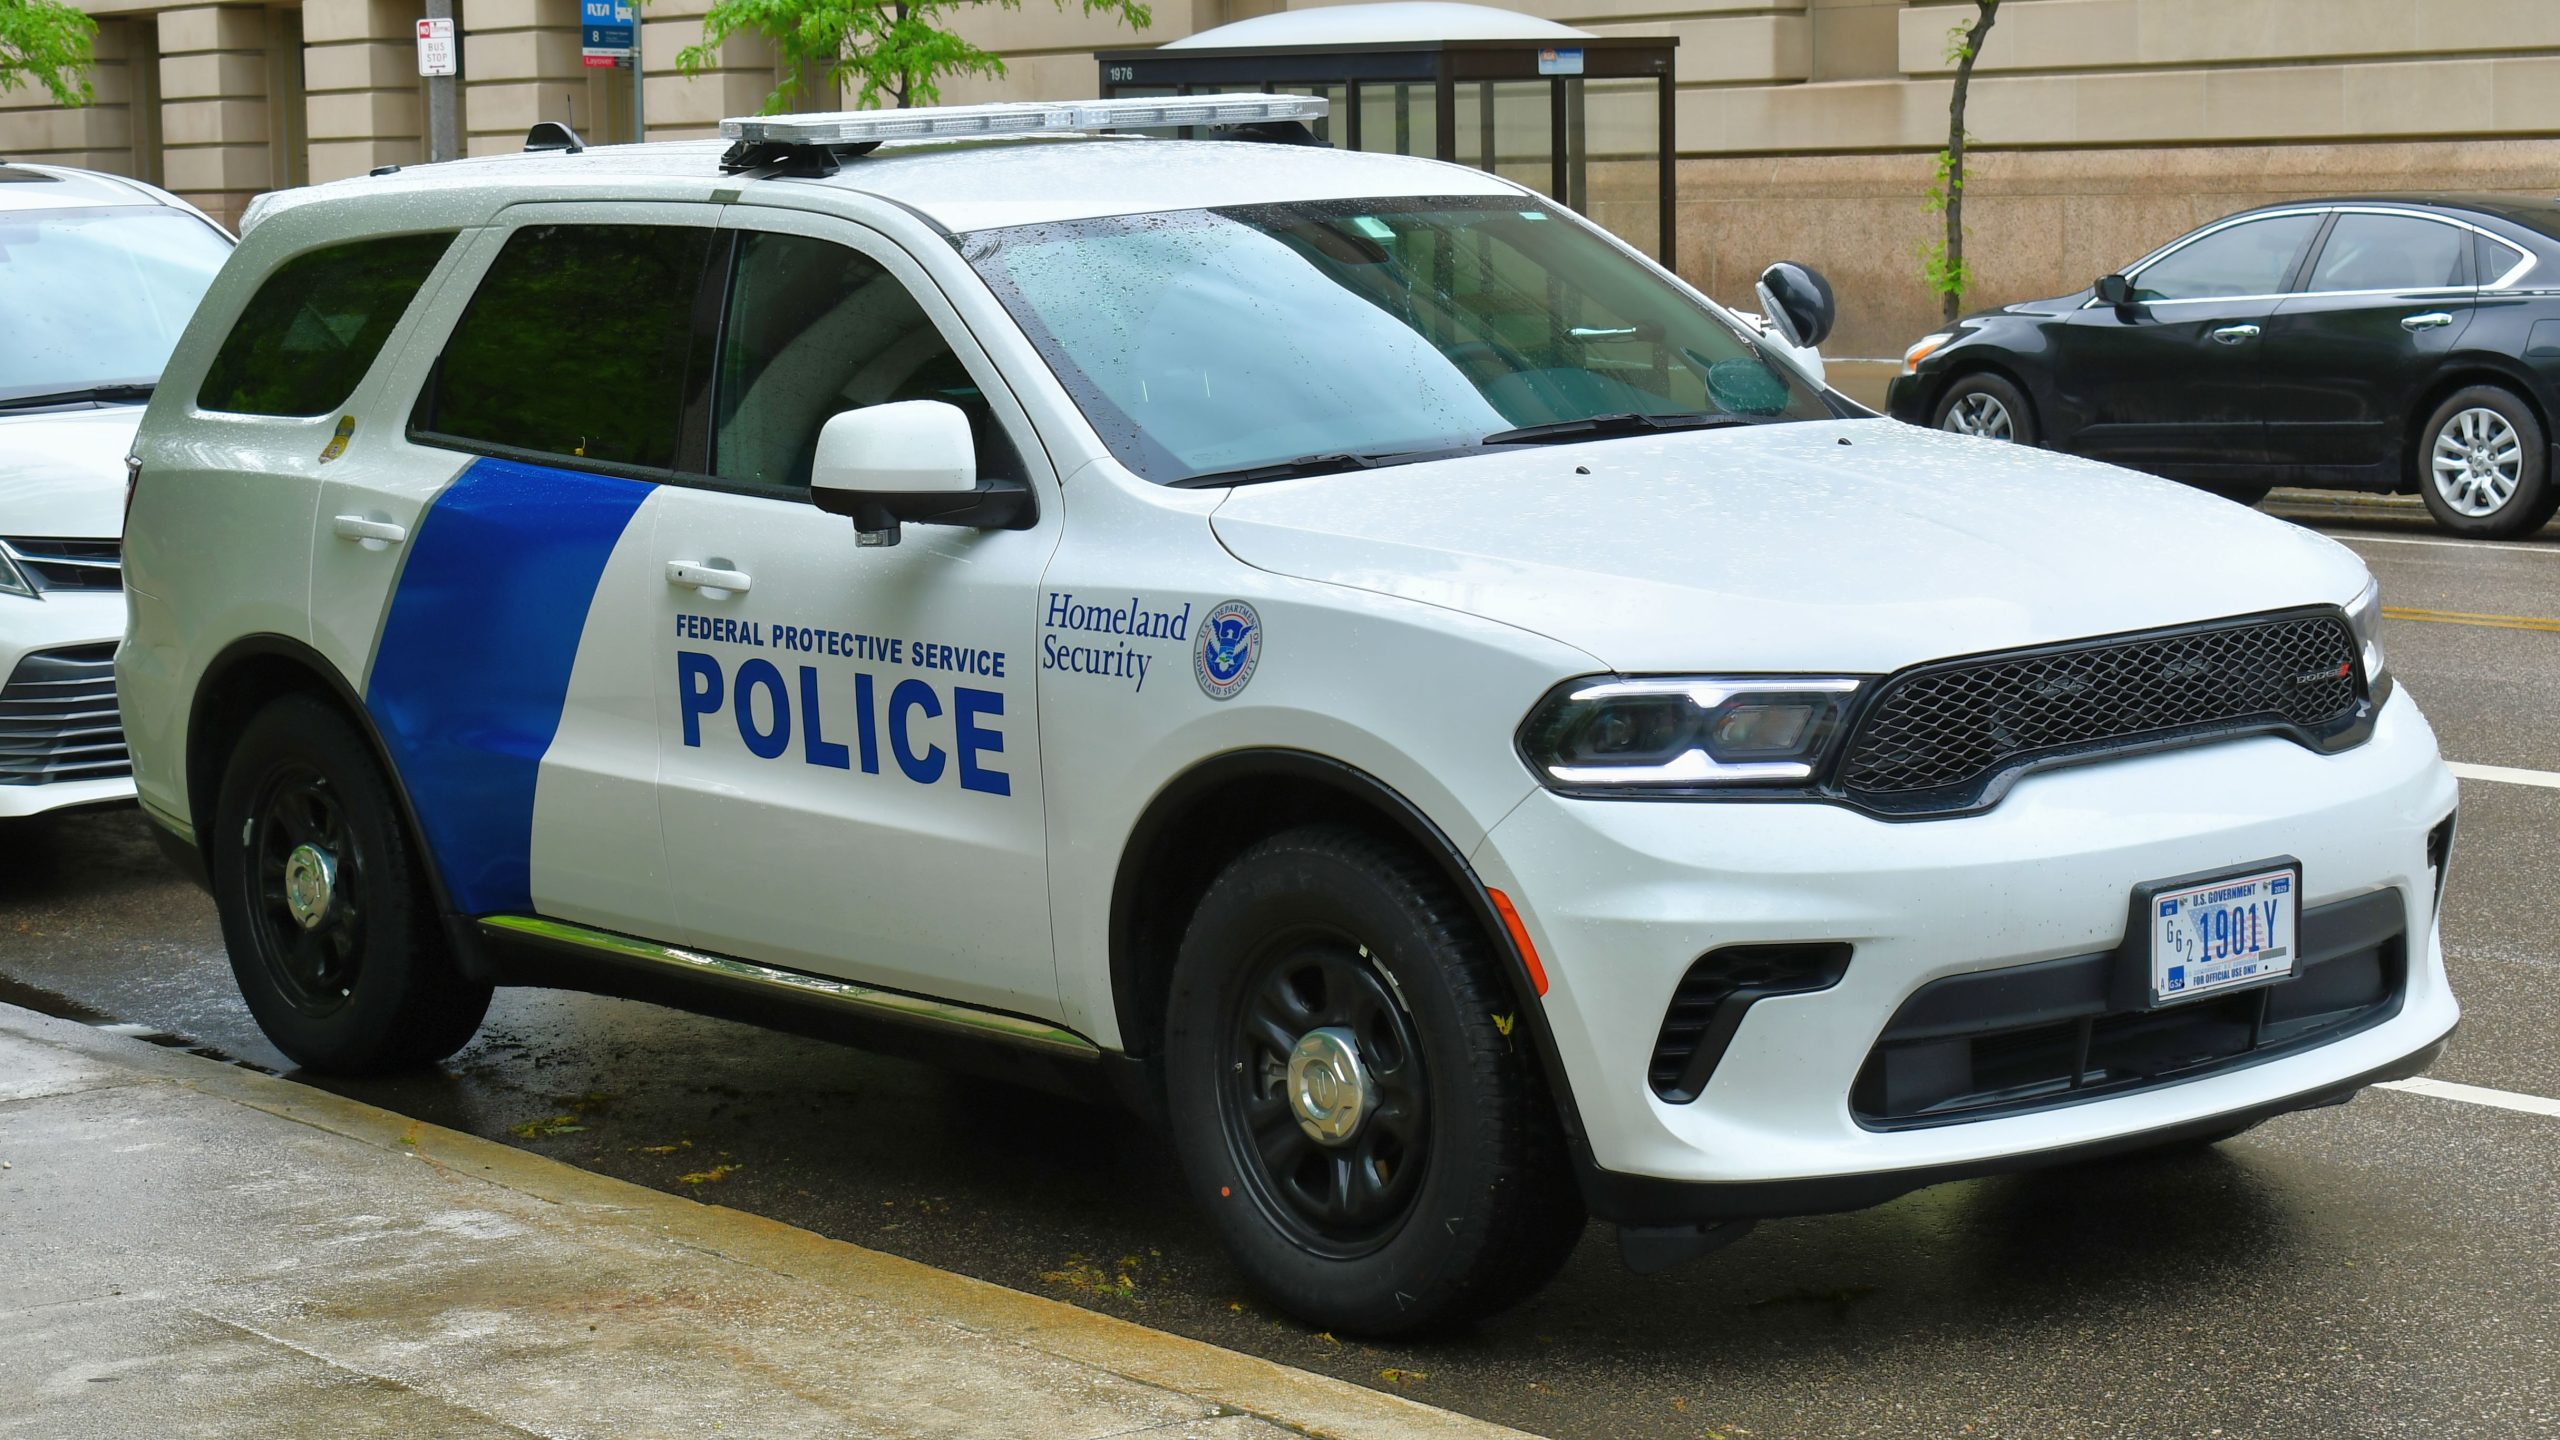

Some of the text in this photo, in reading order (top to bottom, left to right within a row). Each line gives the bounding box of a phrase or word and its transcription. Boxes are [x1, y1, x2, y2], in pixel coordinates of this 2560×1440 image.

[587, 3, 610, 16] RTA
[428, 43, 445, 51] BUS
[592, 30, 599, 42] 8
[427, 53, 447, 62] STOP
[1110, 67, 1133, 80] 1976
[1045, 592, 1191, 641] Homeland
[1215, 605, 1258, 632] DEPARTMENT
[1253, 632, 1259, 646] OF
[676, 614, 1005, 678] FEDERAL PROTECTIVE SERVICE
[1043, 634, 1152, 693] Security
[1196, 651, 1255, 695] HOMELAND SECURITY
[2297, 668, 2340, 683] DODGE
[677, 650, 1011, 797] POLICE
[2193, 883, 2256, 907] U.S. GOVERNMENT
[2200, 899, 2277, 962] 1901Y
[2169, 978, 2183, 989] GSA
[2193, 975, 2204, 986] FOR
[2206, 969, 2230, 983] OFFICIAL
[2231, 967, 2242, 978] USE
[2243, 964, 2257, 975] ONLY
